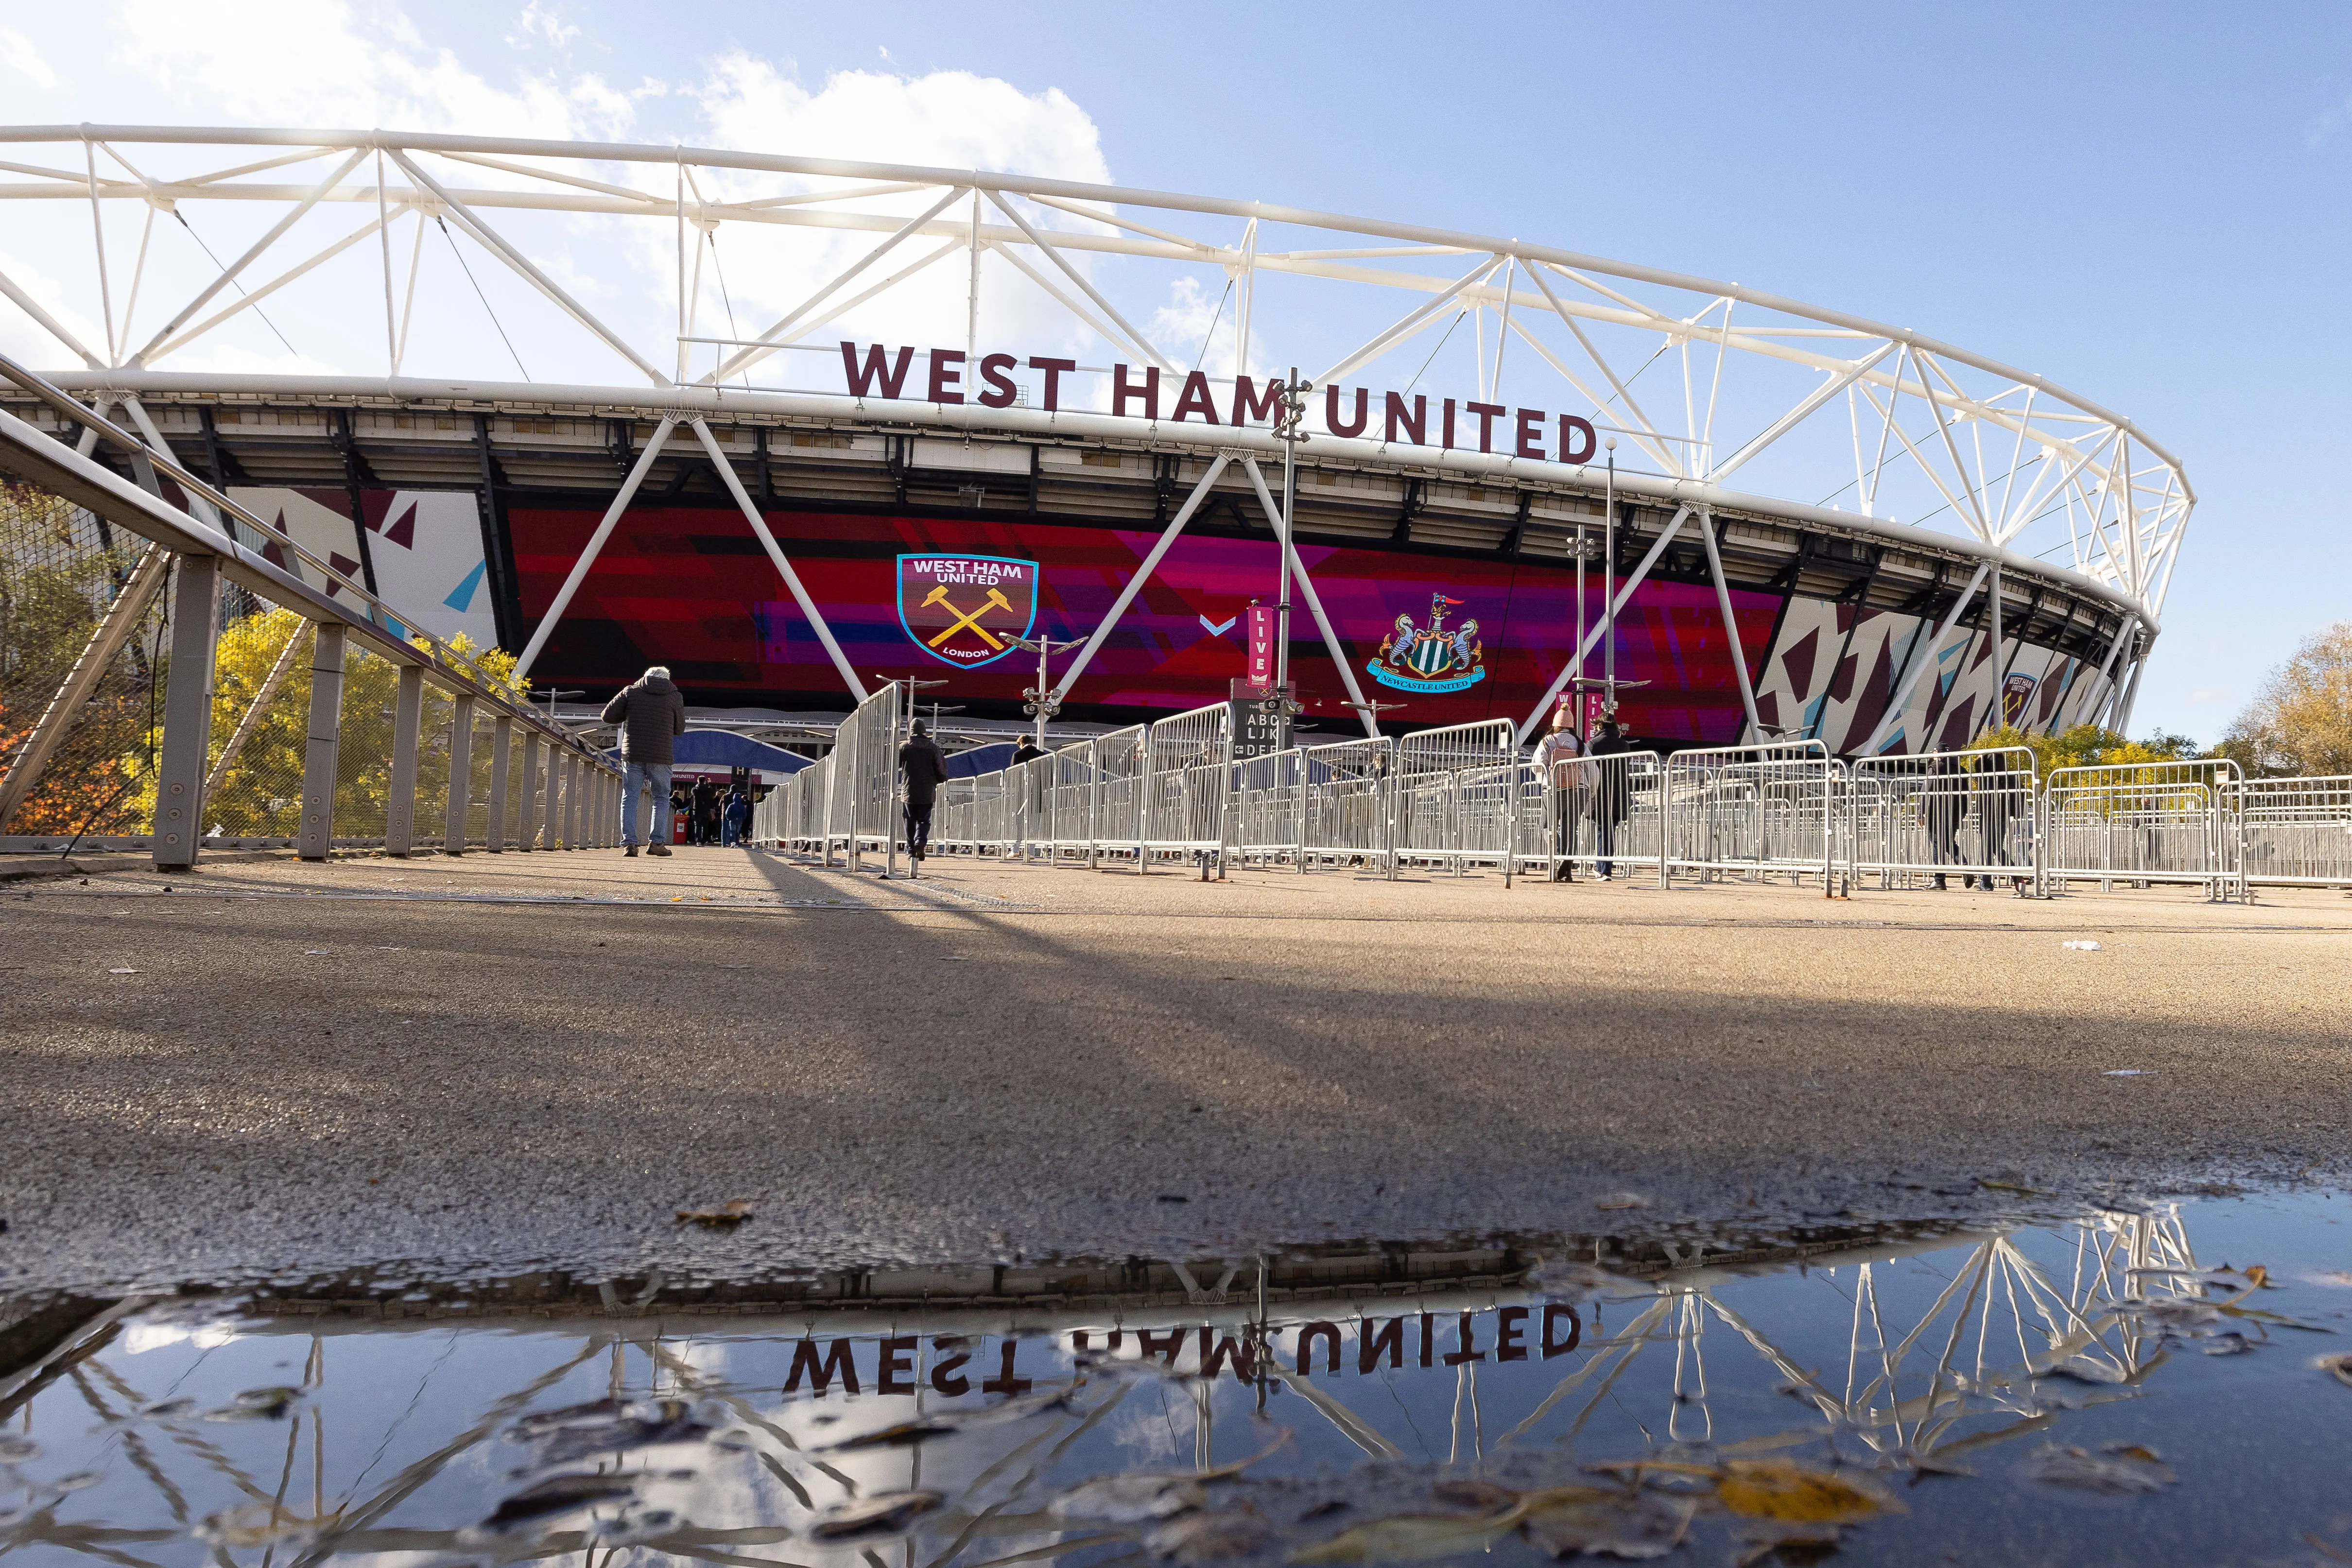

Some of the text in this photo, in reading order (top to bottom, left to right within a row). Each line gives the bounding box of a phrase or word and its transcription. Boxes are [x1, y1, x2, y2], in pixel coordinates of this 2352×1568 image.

[840, 341, 1596, 465] WEST HAM UNITED
[914, 560, 1022, 579] WEST HAM
[936, 572, 999, 586] UNITED
[1256, 610, 1266, 670] LIVE
[943, 647, 989, 658] LONDON
[1381, 675, 1468, 690] NEWCASTLE UNITED
[2022, 679, 2033, 689] HAM
[1248, 714, 1278, 725] A B C
[1248, 728, 1277, 739] L J K
[1247, 744, 1255, 756] D
[737, 766, 744, 775] H
